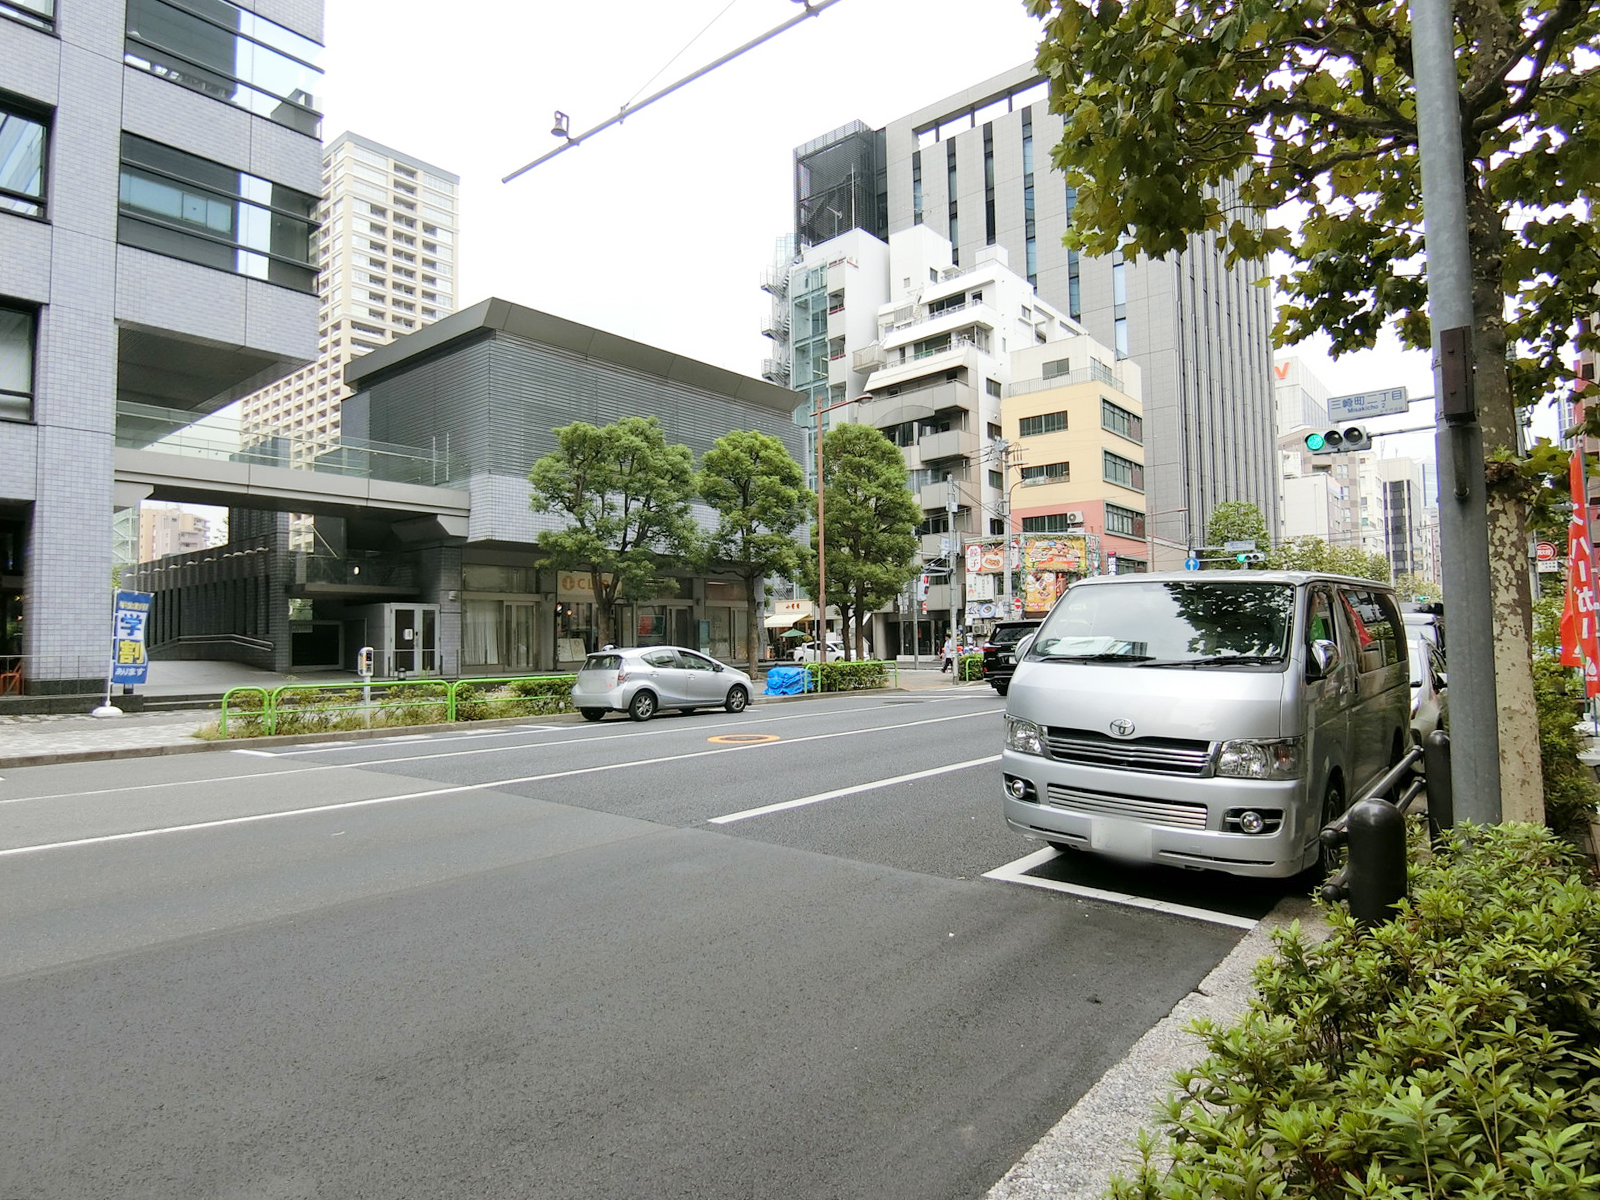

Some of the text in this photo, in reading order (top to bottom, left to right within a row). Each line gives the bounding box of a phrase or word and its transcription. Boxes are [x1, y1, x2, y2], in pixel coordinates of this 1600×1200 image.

[1331, 389, 1402, 410] 三崎町二丁目
[1348, 404, 1379, 413] Misakicho
[119, 612, 145, 664] 学割
[115, 667, 146, 677] あります
